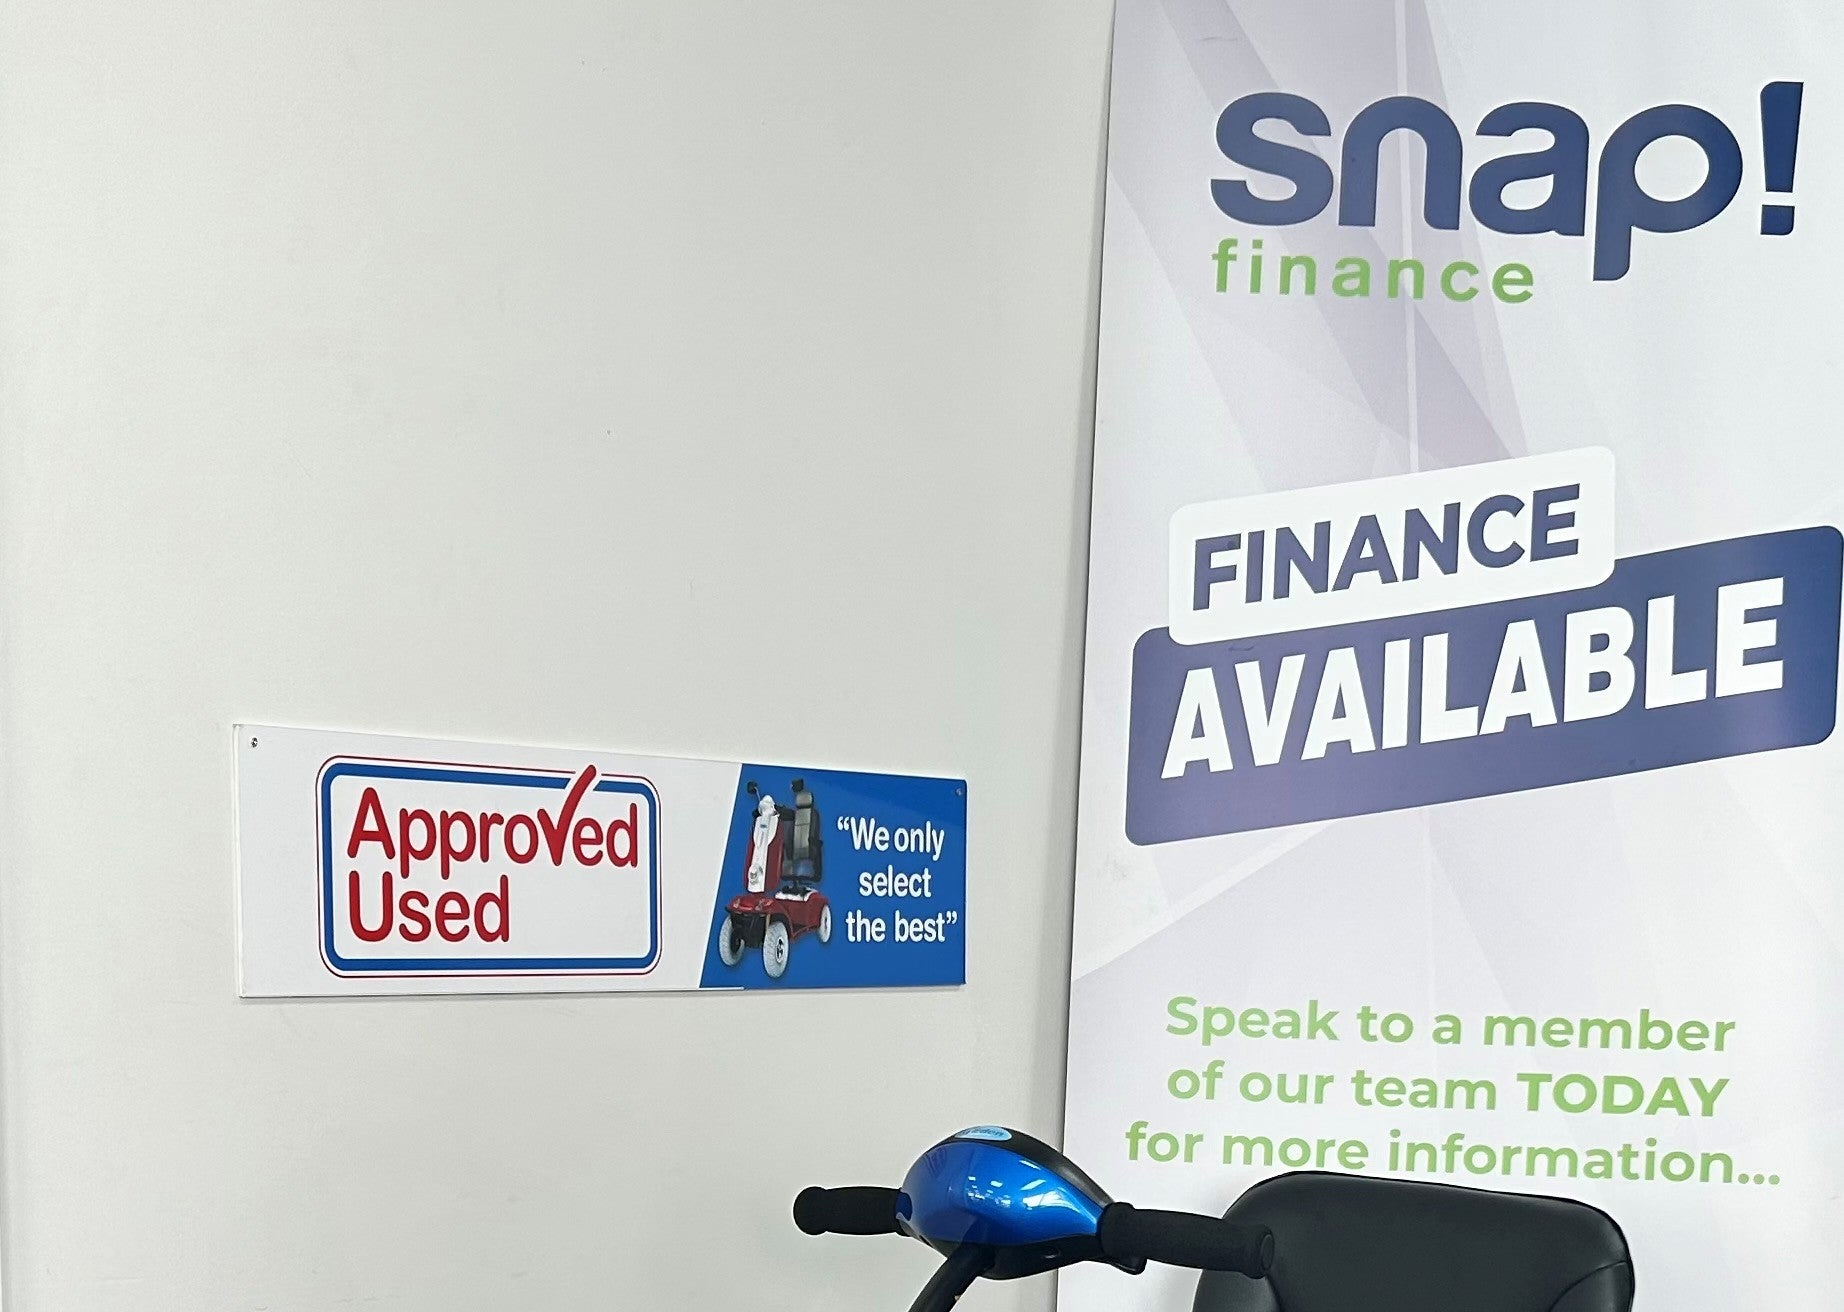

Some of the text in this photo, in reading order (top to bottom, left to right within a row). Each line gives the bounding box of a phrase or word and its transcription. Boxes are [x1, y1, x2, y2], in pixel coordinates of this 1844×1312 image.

[1209, 81, 1804, 281] snap!
[1211, 238, 1535, 304] finance
[1192, 483, 1581, 611] FINANCE
[1160, 577, 1785, 780] AVAILABLE
[347, 765, 638, 880] Approved
[894, 820, 945, 861] only
[348, 870, 509, 942] Used
[859, 864, 932, 898] select
[845, 909, 886, 942] the
[1165, 996, 1736, 1051] Speak to a member
[1167, 1059, 1731, 1117] of our team TODAY
[1125, 1120, 1781, 1186] for more information...
